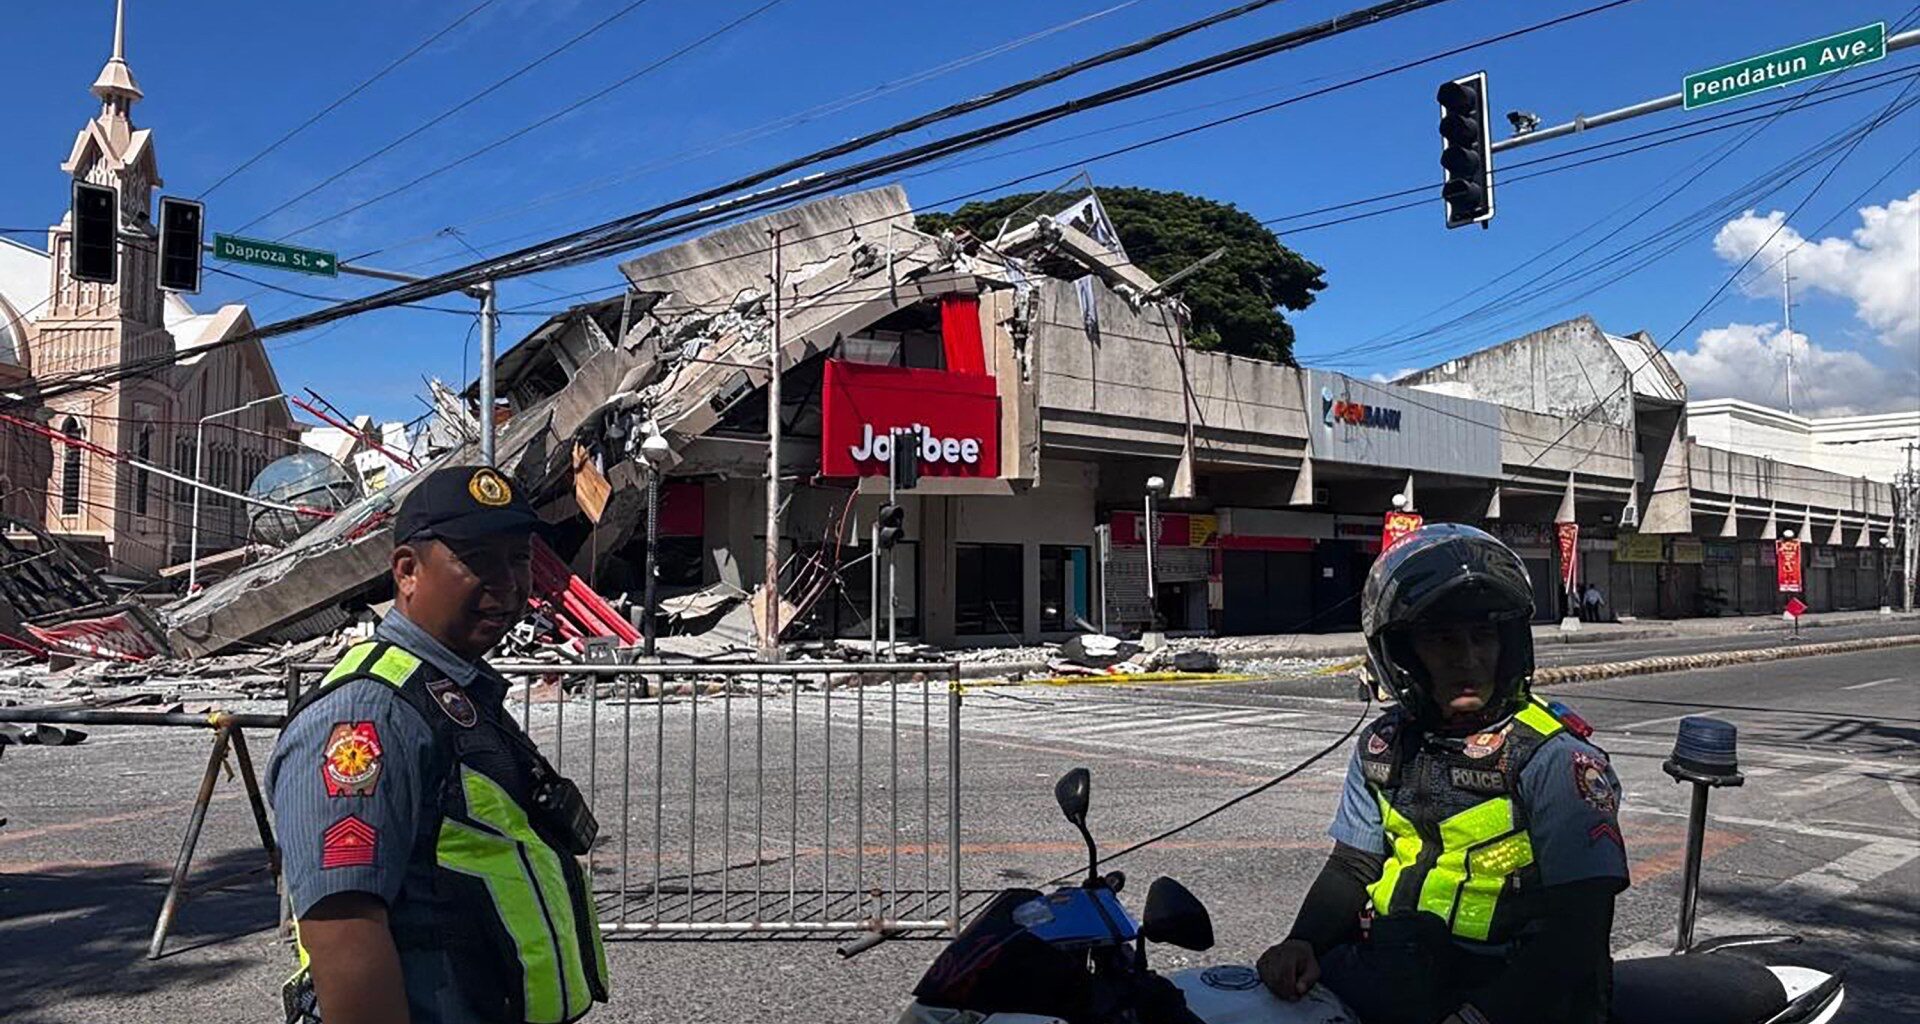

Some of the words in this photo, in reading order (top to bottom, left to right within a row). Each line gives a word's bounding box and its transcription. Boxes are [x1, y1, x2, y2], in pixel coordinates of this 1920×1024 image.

[1693, 56, 1807, 99] Pendatun
[1819, 39, 1874, 66] Ave.
[225, 242, 286, 263] Daproza
[292, 253, 311, 267] St.
[1452, 768, 1504, 789] POLICE
